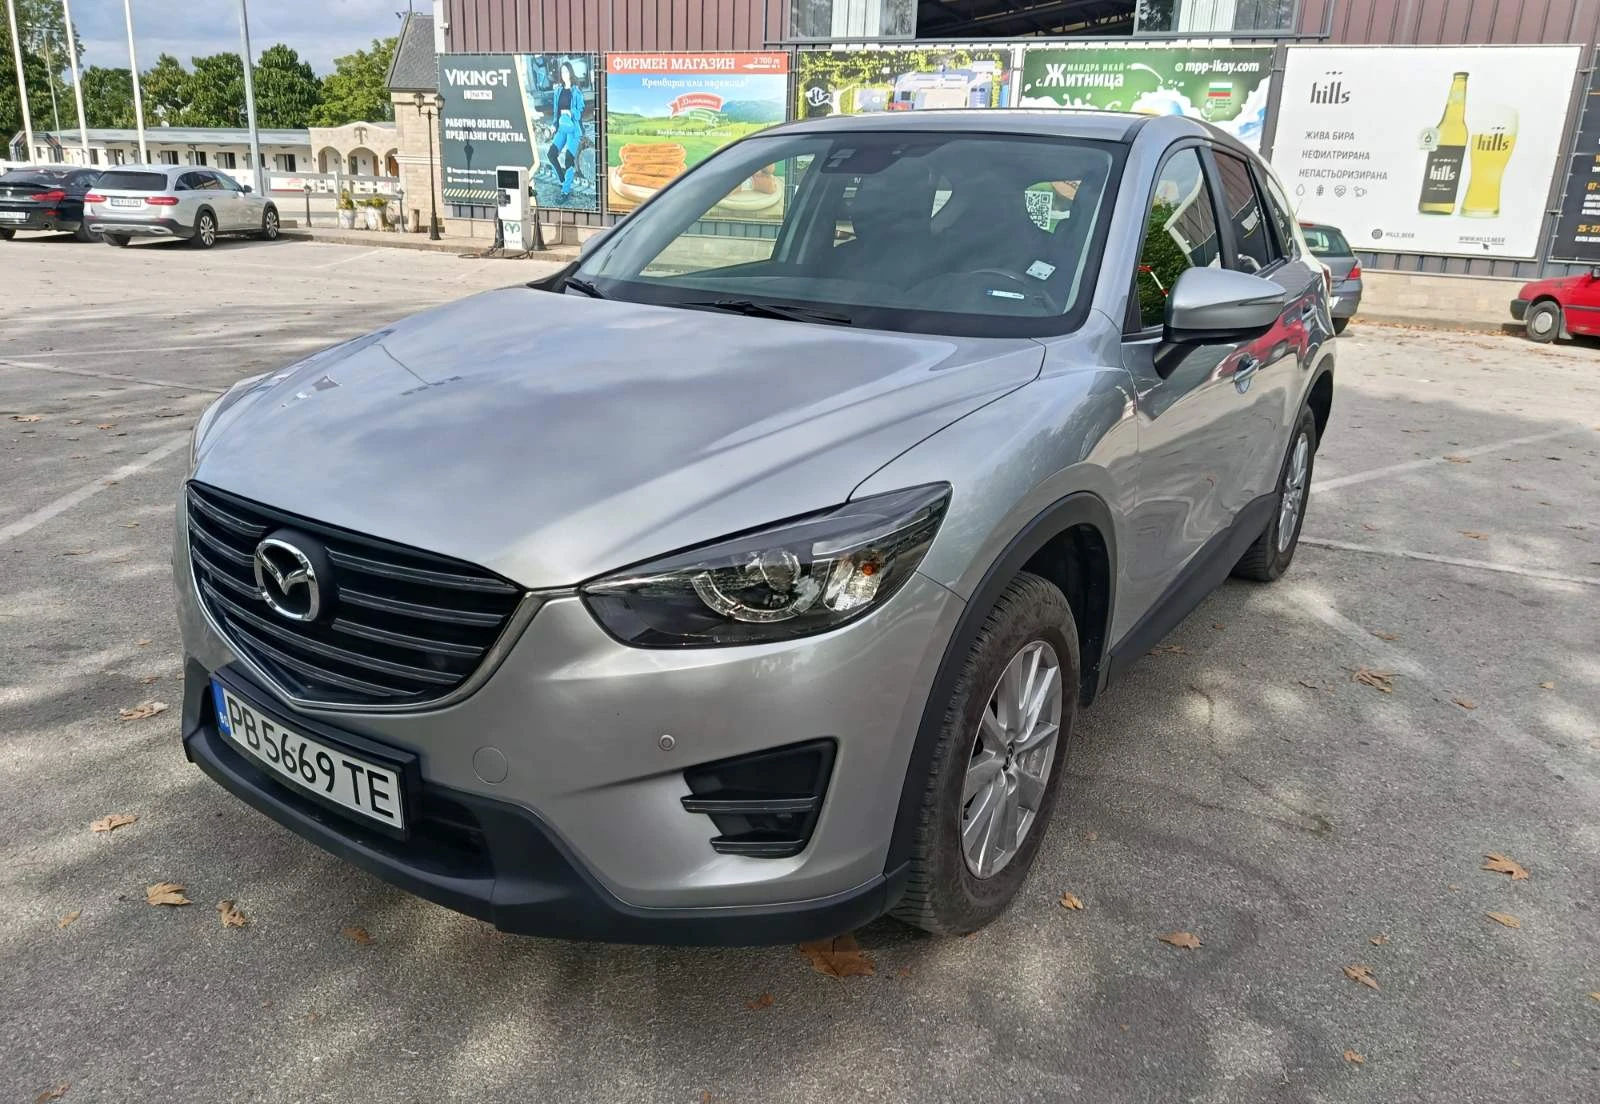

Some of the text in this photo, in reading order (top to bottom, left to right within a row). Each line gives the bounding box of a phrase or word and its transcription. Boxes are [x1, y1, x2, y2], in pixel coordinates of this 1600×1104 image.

[613, 57, 735, 70] ФИРМЕН МАГАЗИН
[1067, 62, 1124, 72] МАНДРА ИКАЙ
[1185, 60, 1260, 74] mpp-ikay.com
[444, 69, 511, 87] VIKING-T
[1310, 81, 1351, 104] hills
[445, 118, 476, 128] РАБОТНО
[445, 130, 487, 141] ПРЕДПАЗНИ
[1305, 131, 1355, 140] ЖИВА БИРА
[1477, 133, 1509, 151] hills
[1301, 150, 1370, 160] НЕФИЛТРИРАНА
[1298, 168, 1388, 180] НЕПАСТЬОРИЗИРАНА
[1429, 165, 1456, 181] hills
